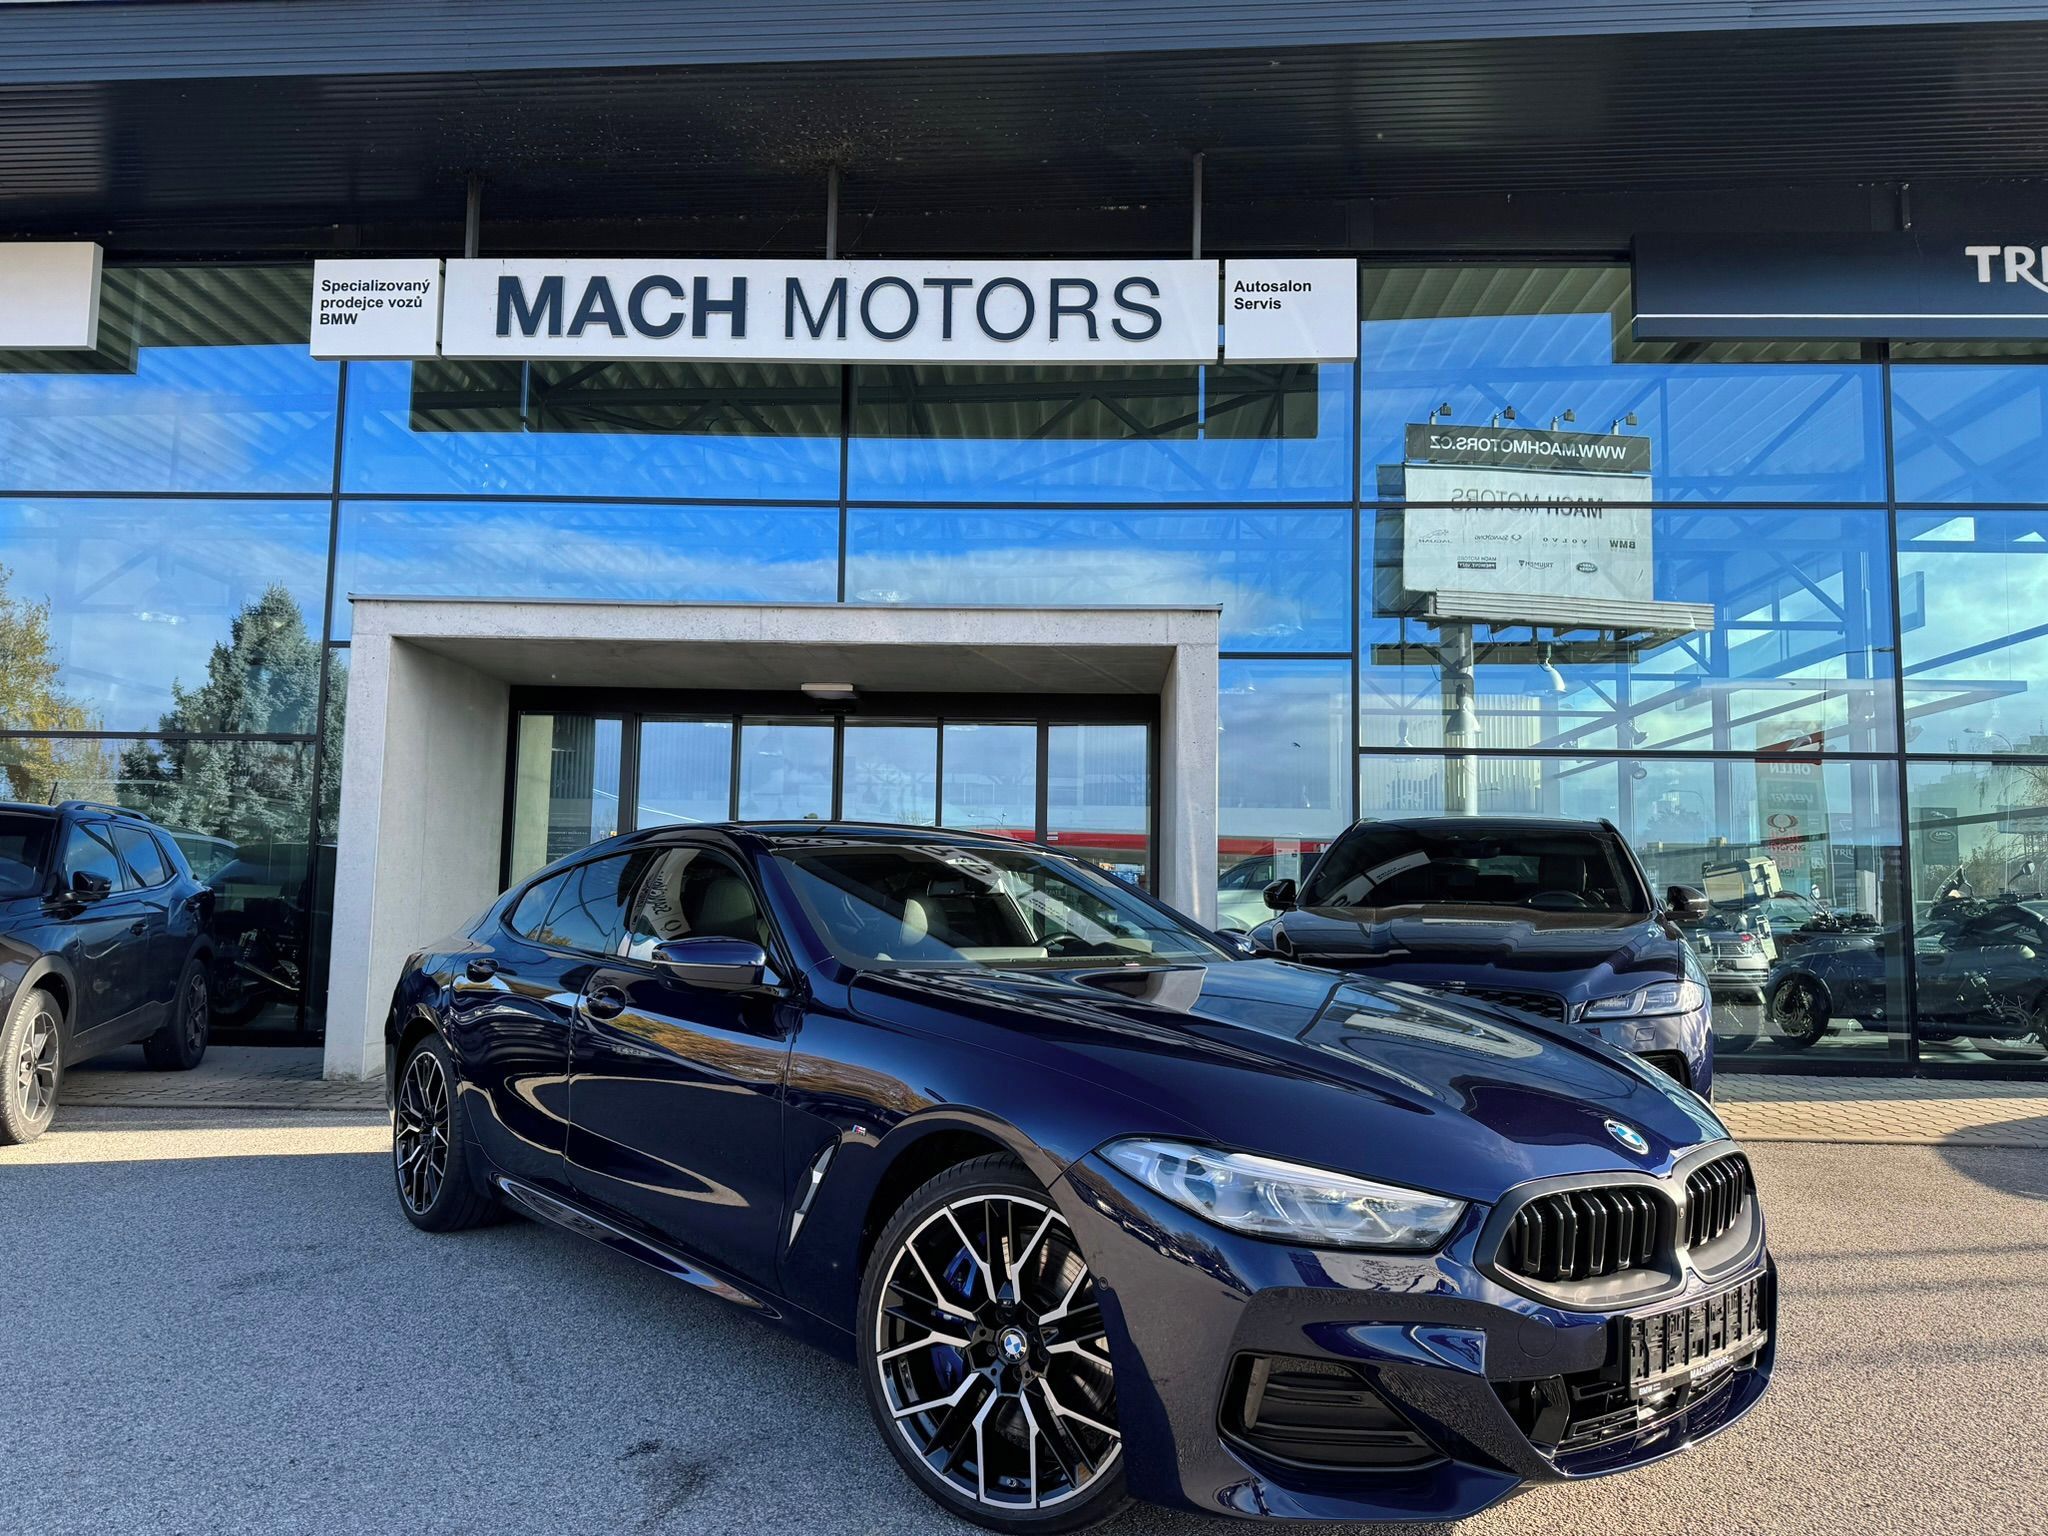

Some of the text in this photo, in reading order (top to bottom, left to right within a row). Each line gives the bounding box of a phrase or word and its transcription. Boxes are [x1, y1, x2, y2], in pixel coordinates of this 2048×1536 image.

[321, 279, 430, 294] Specializovaný
[1233, 280, 1312, 292] Autosalon
[320, 295, 422, 310] prodejce vozů
[495, 275, 1163, 342] MACH MOTORS
[1233, 297, 1282, 310] Servis
[319, 313, 358, 325] BMW
